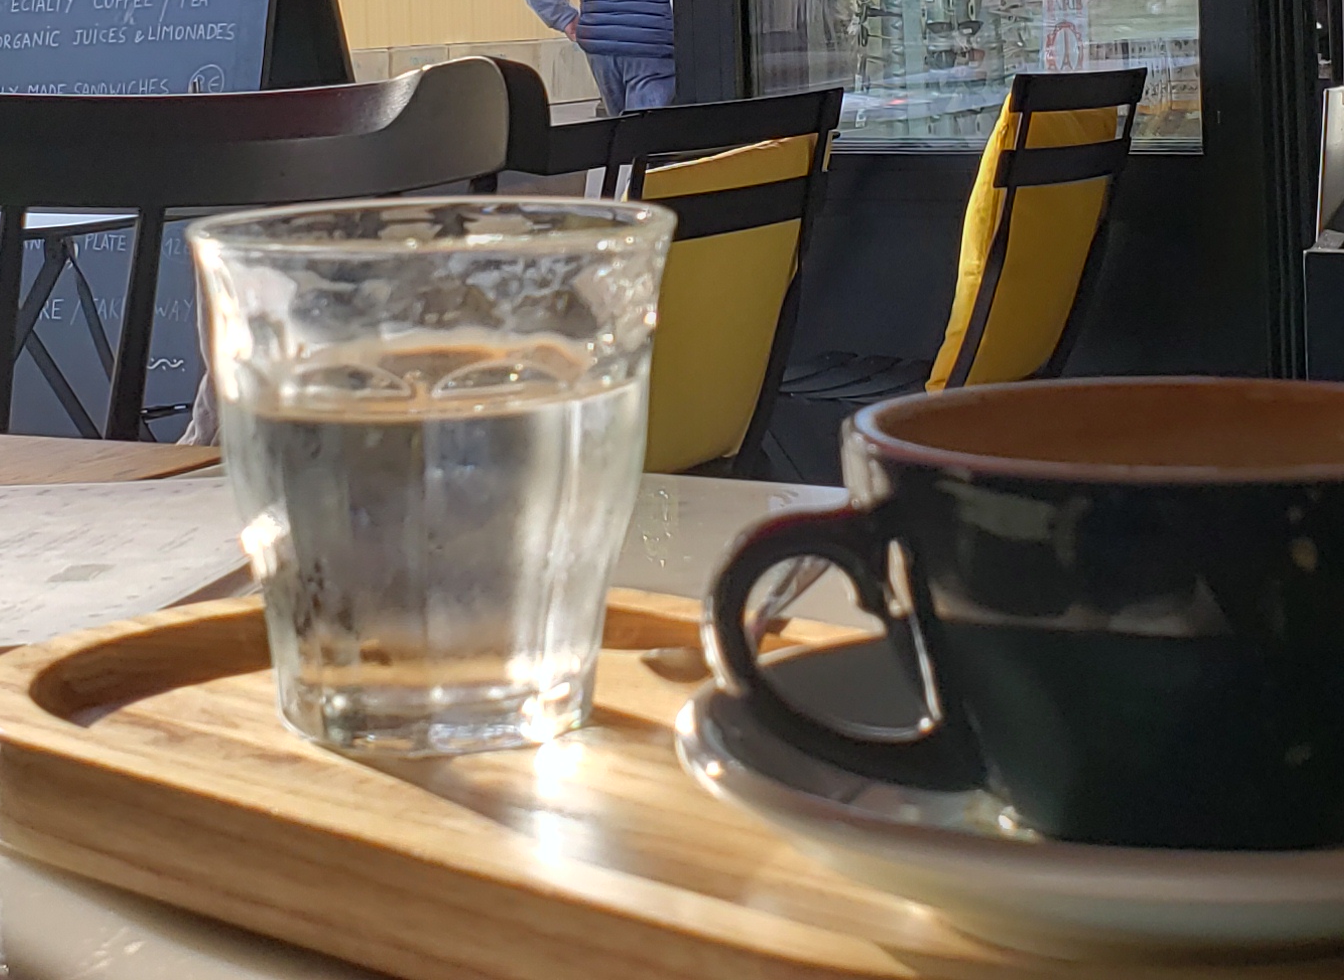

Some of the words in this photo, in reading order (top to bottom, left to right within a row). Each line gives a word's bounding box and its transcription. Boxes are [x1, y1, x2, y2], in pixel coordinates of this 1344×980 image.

[72, 22, 128, 46] JUICES
[147, 22, 237, 42] LIMONADES
[83, 233, 128, 252] PLATE
[154, 297, 194, 322] WAY
